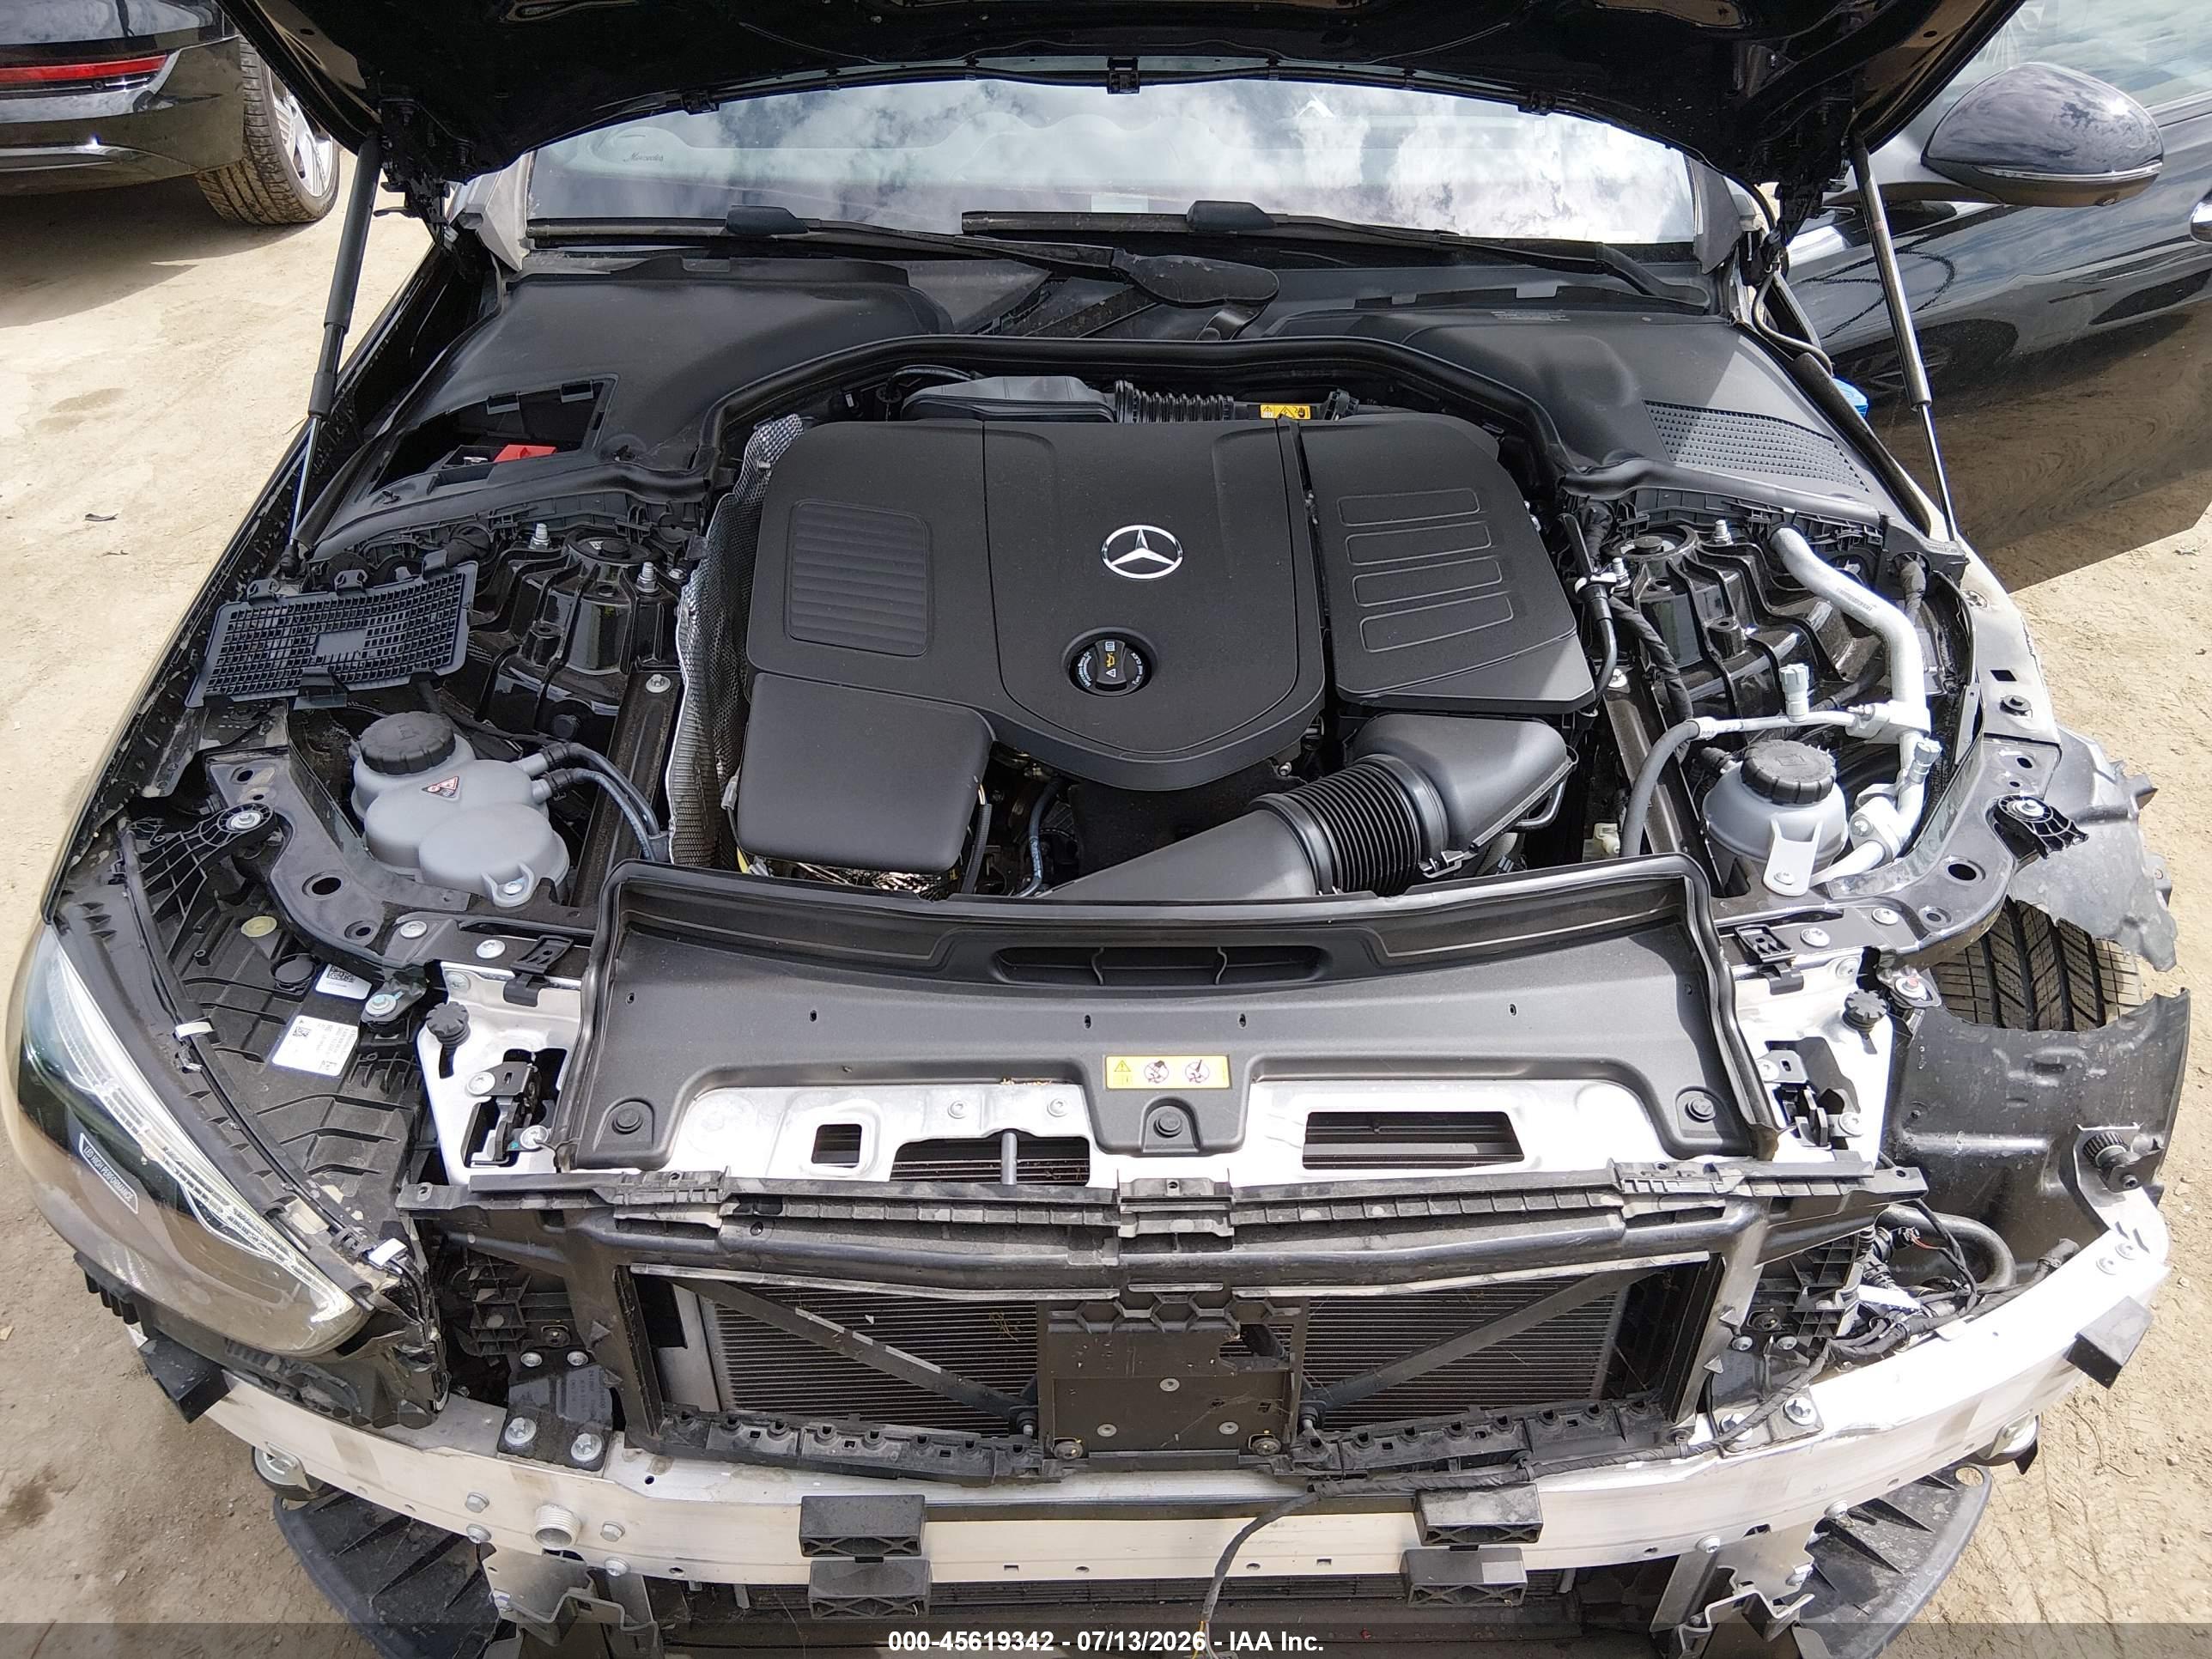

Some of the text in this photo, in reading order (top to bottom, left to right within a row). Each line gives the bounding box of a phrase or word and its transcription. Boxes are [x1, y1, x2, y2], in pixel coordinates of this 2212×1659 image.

[1131, 653, 1142, 665] CLICK
[83, 1146, 134, 1201] LED HIGH PERFORMANCE
